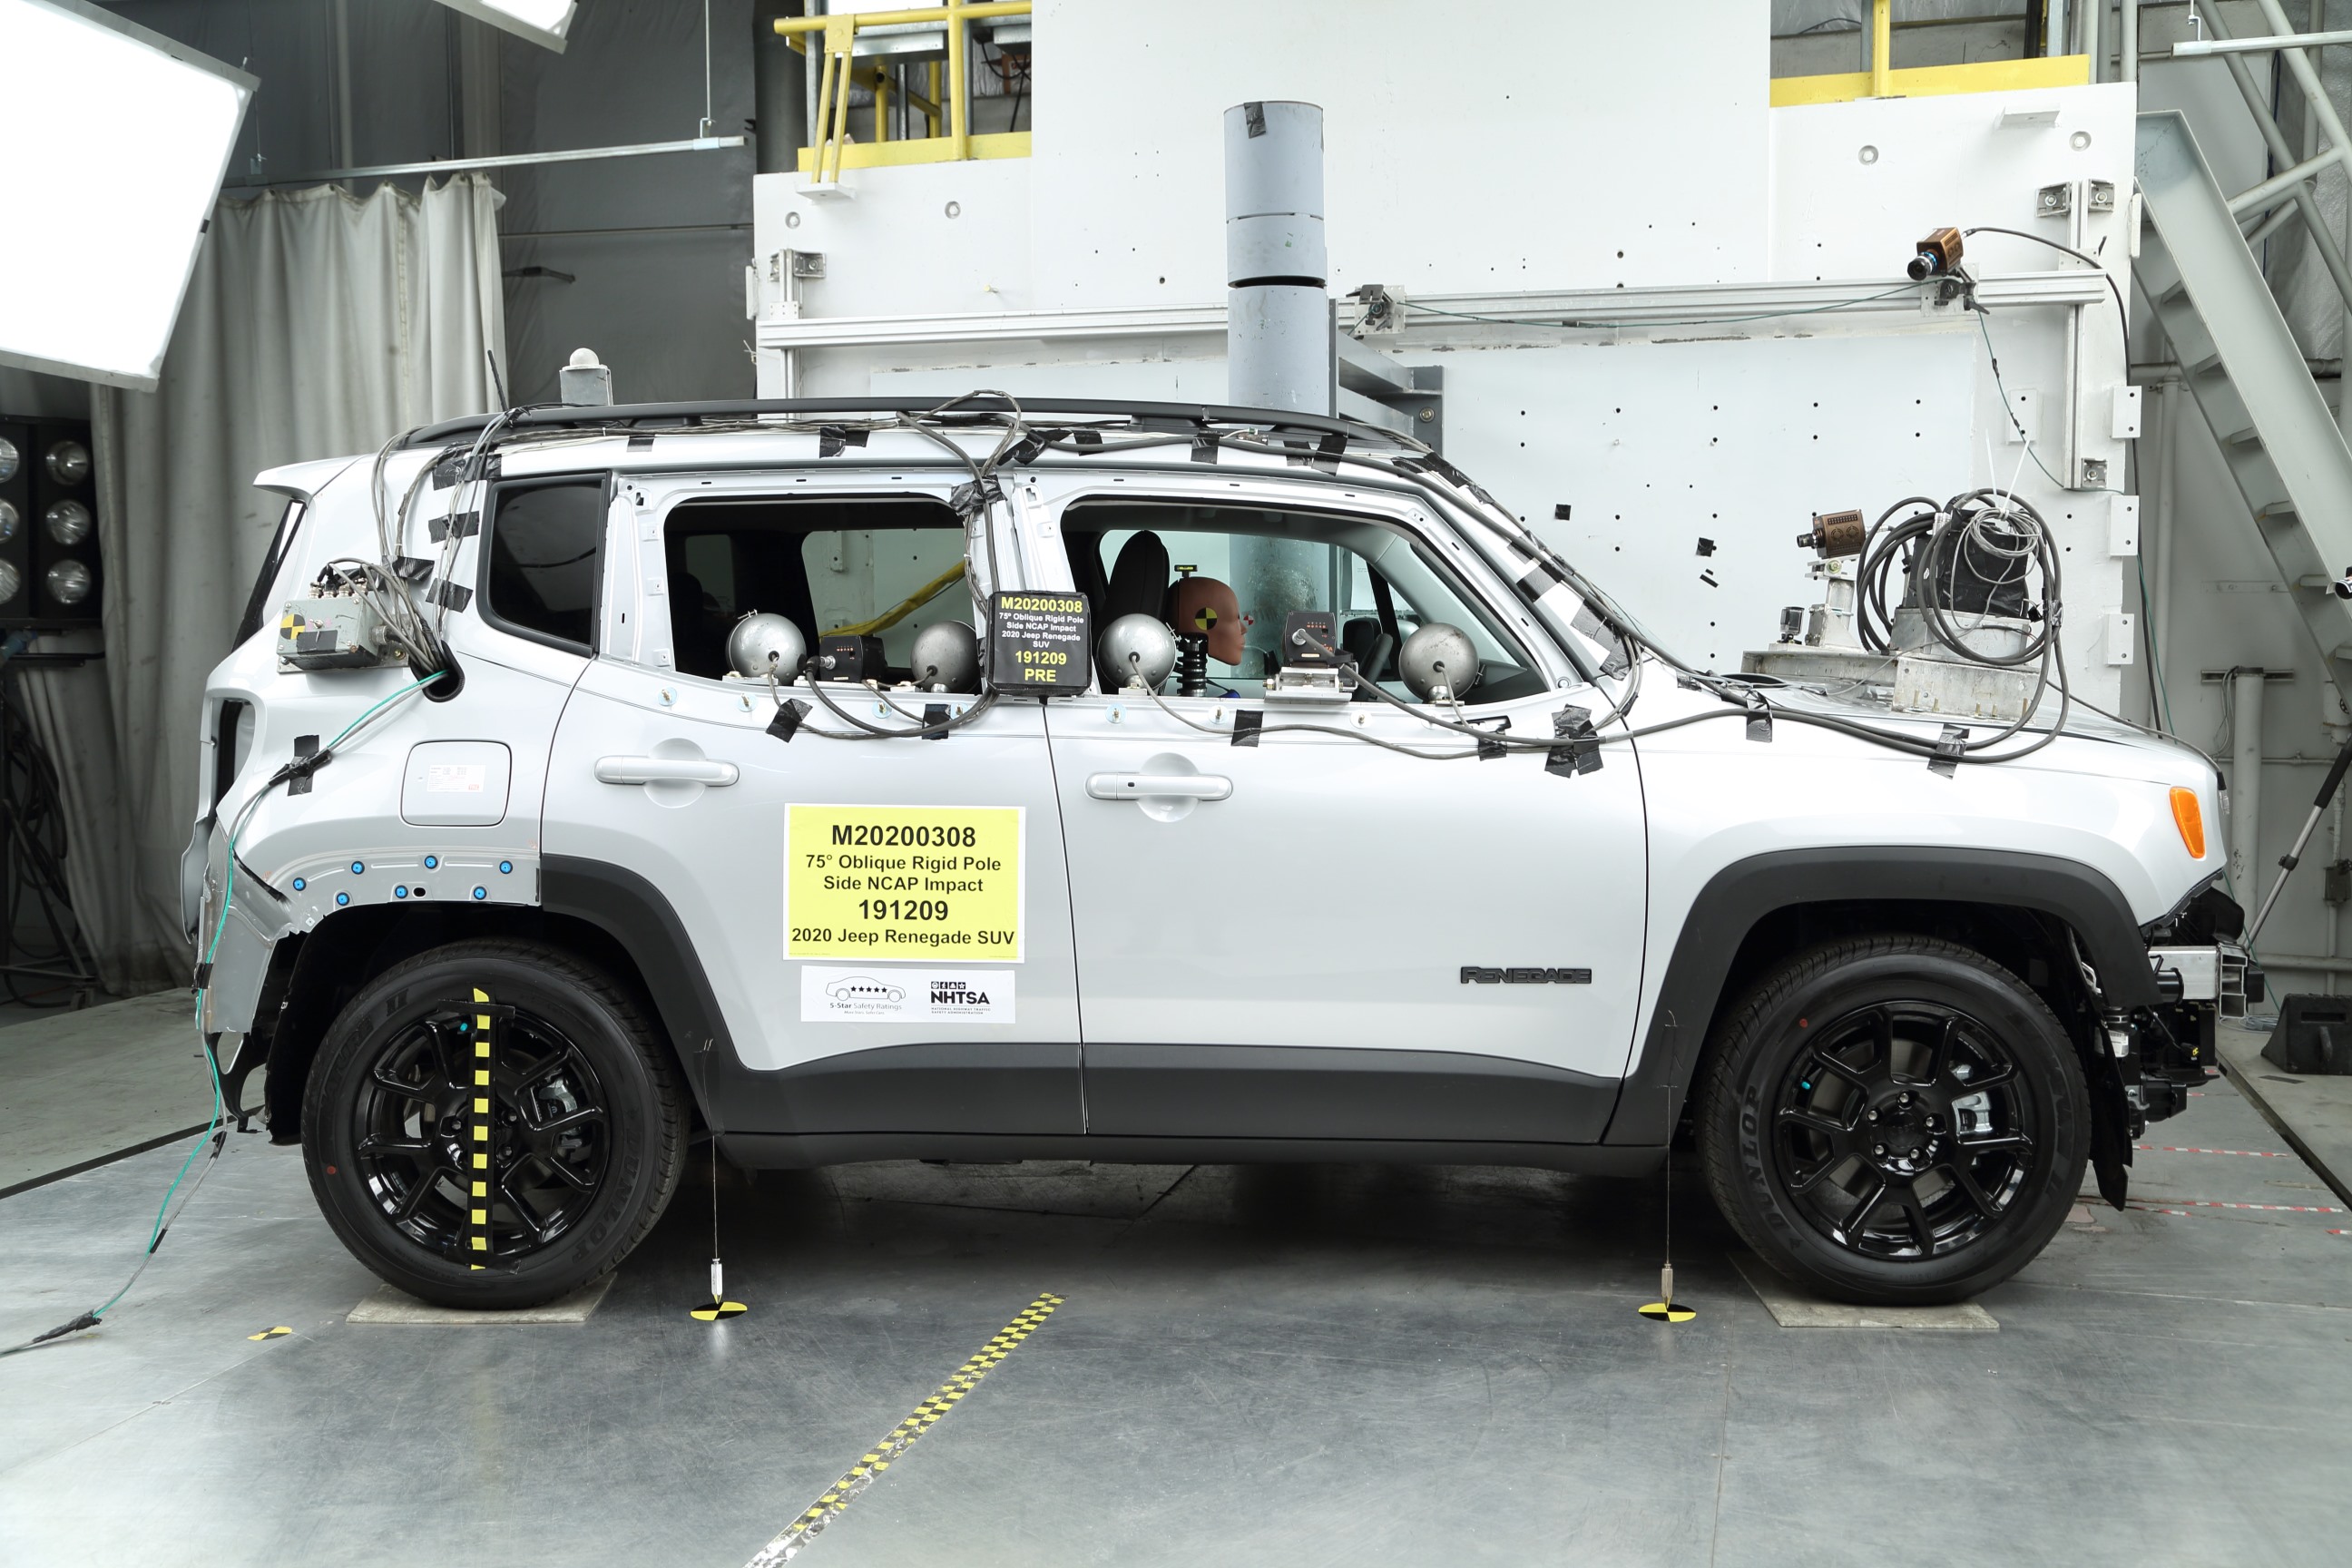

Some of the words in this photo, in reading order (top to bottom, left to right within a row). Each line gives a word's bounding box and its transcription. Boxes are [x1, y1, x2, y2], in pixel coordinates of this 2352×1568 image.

[1001, 596, 1083, 613] M20200308
[1006, 622, 1024, 630] Side
[1025, 622, 1049, 631] NCAP
[1050, 623, 1077, 632] Impact
[1013, 612, 1044, 622] Oblique
[1044, 615, 1065, 624] Rigid
[1066, 616, 1084, 624] Pole
[1022, 631, 1041, 641] Jeep
[1043, 632, 1081, 642] Renegade
[1015, 651, 1067, 665] 191209
[1024, 668, 1056, 682] PRE
[831, 825, 976, 848] M20200308
[838, 854, 906, 873] Oblique
[912, 856, 957, 874] Rigid
[963, 856, 1002, 872] Pole
[823, 876, 862, 890] Side
[867, 877, 919, 891] NCAP
[924, 877, 984, 895] Impact
[858, 899, 949, 921] 191209
[791, 928, 832, 942] 2020
[838, 928, 879, 946] Jeep
[885, 929, 972, 947] Renegade
[977, 930, 1015, 945] SUV
[1460, 965, 1592, 984] RENEGADE
[930, 990, 990, 1004] NHTSA
[853, 1002, 876, 1011] Safety
[876, 1003, 902, 1012] Ratings
[1741, 1084, 1791, 1231] DUNLOP
[573, 1129, 642, 1265] DUNLOP
